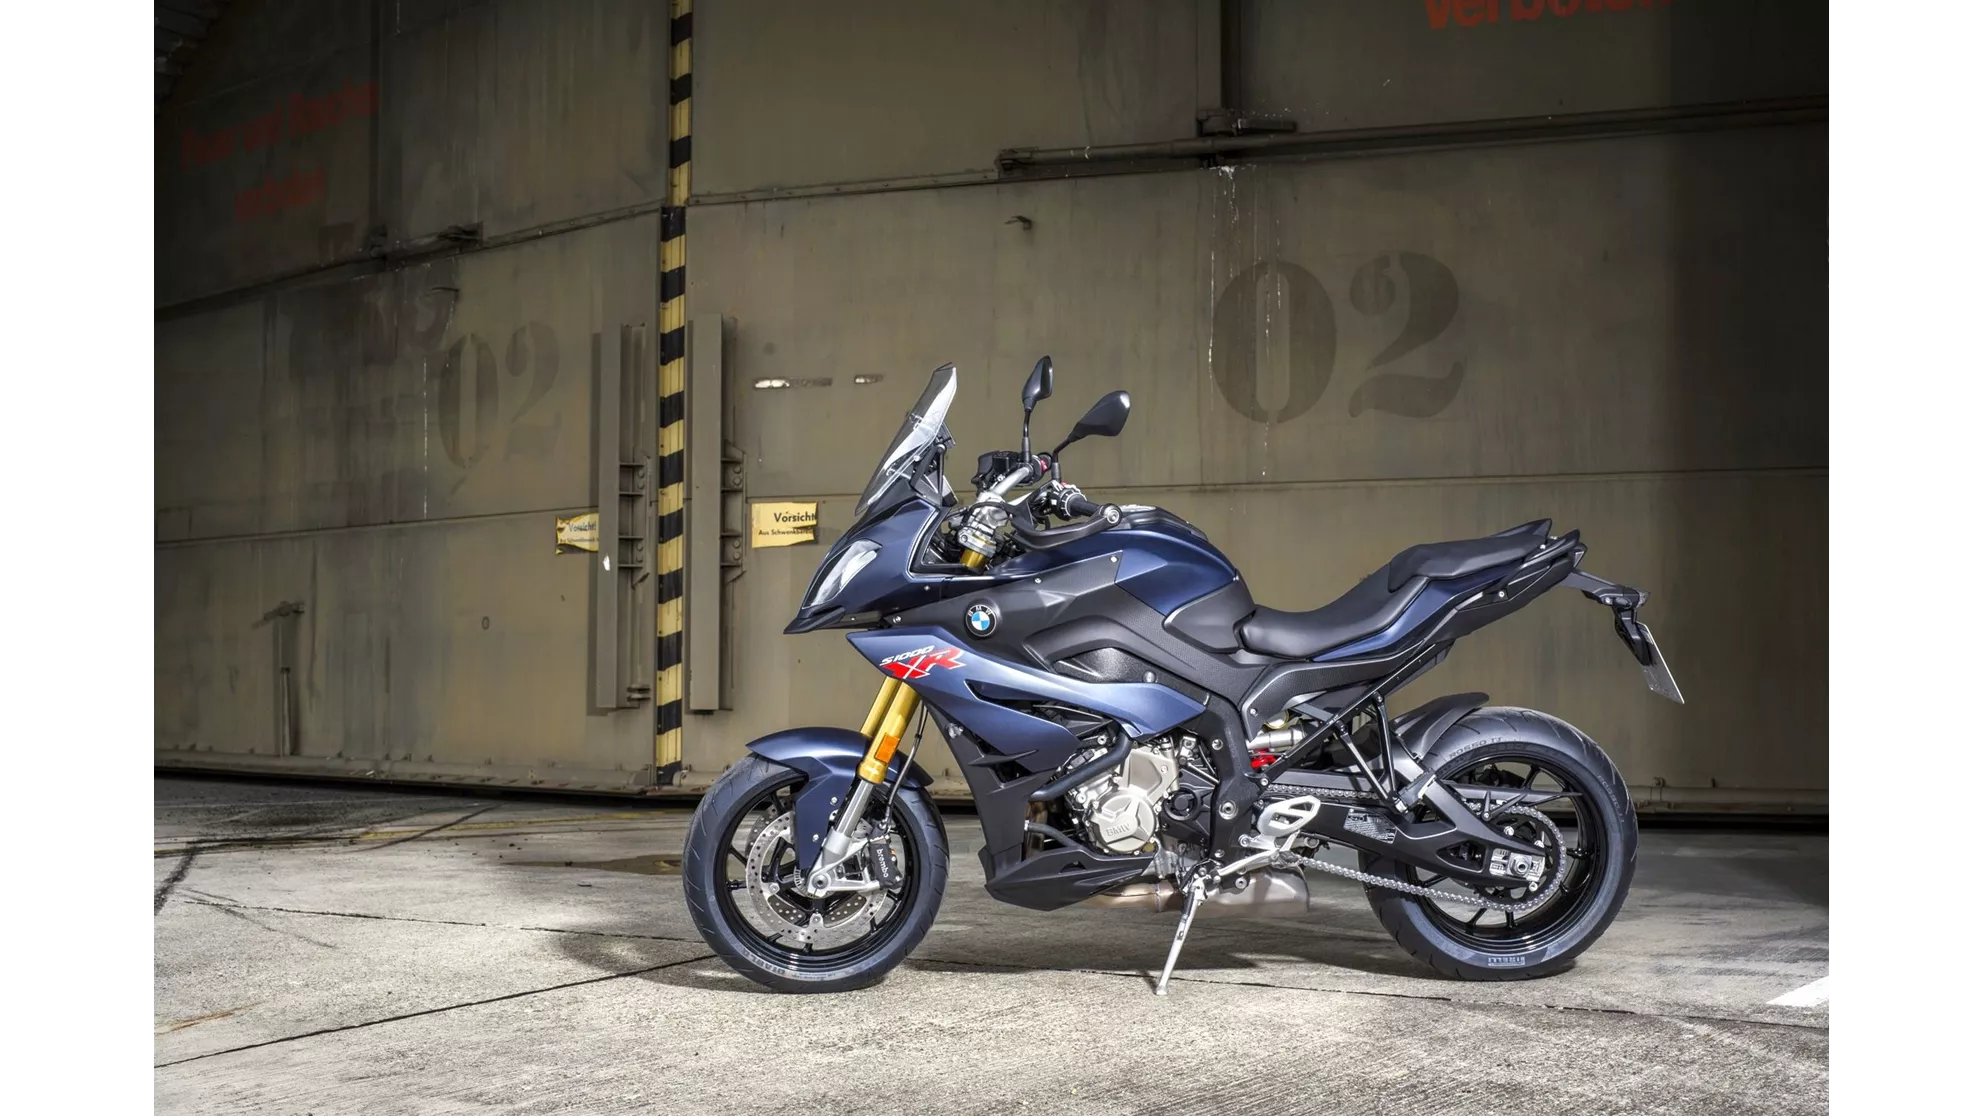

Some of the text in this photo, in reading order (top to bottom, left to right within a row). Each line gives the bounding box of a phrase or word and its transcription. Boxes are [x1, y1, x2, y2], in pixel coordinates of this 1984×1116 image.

[1212, 252, 1464, 422] 02
[438, 321, 562, 468] 02
[967, 605, 993, 617] BMW
[882, 647, 967, 679] XR
[876, 848, 889, 878] brembo
